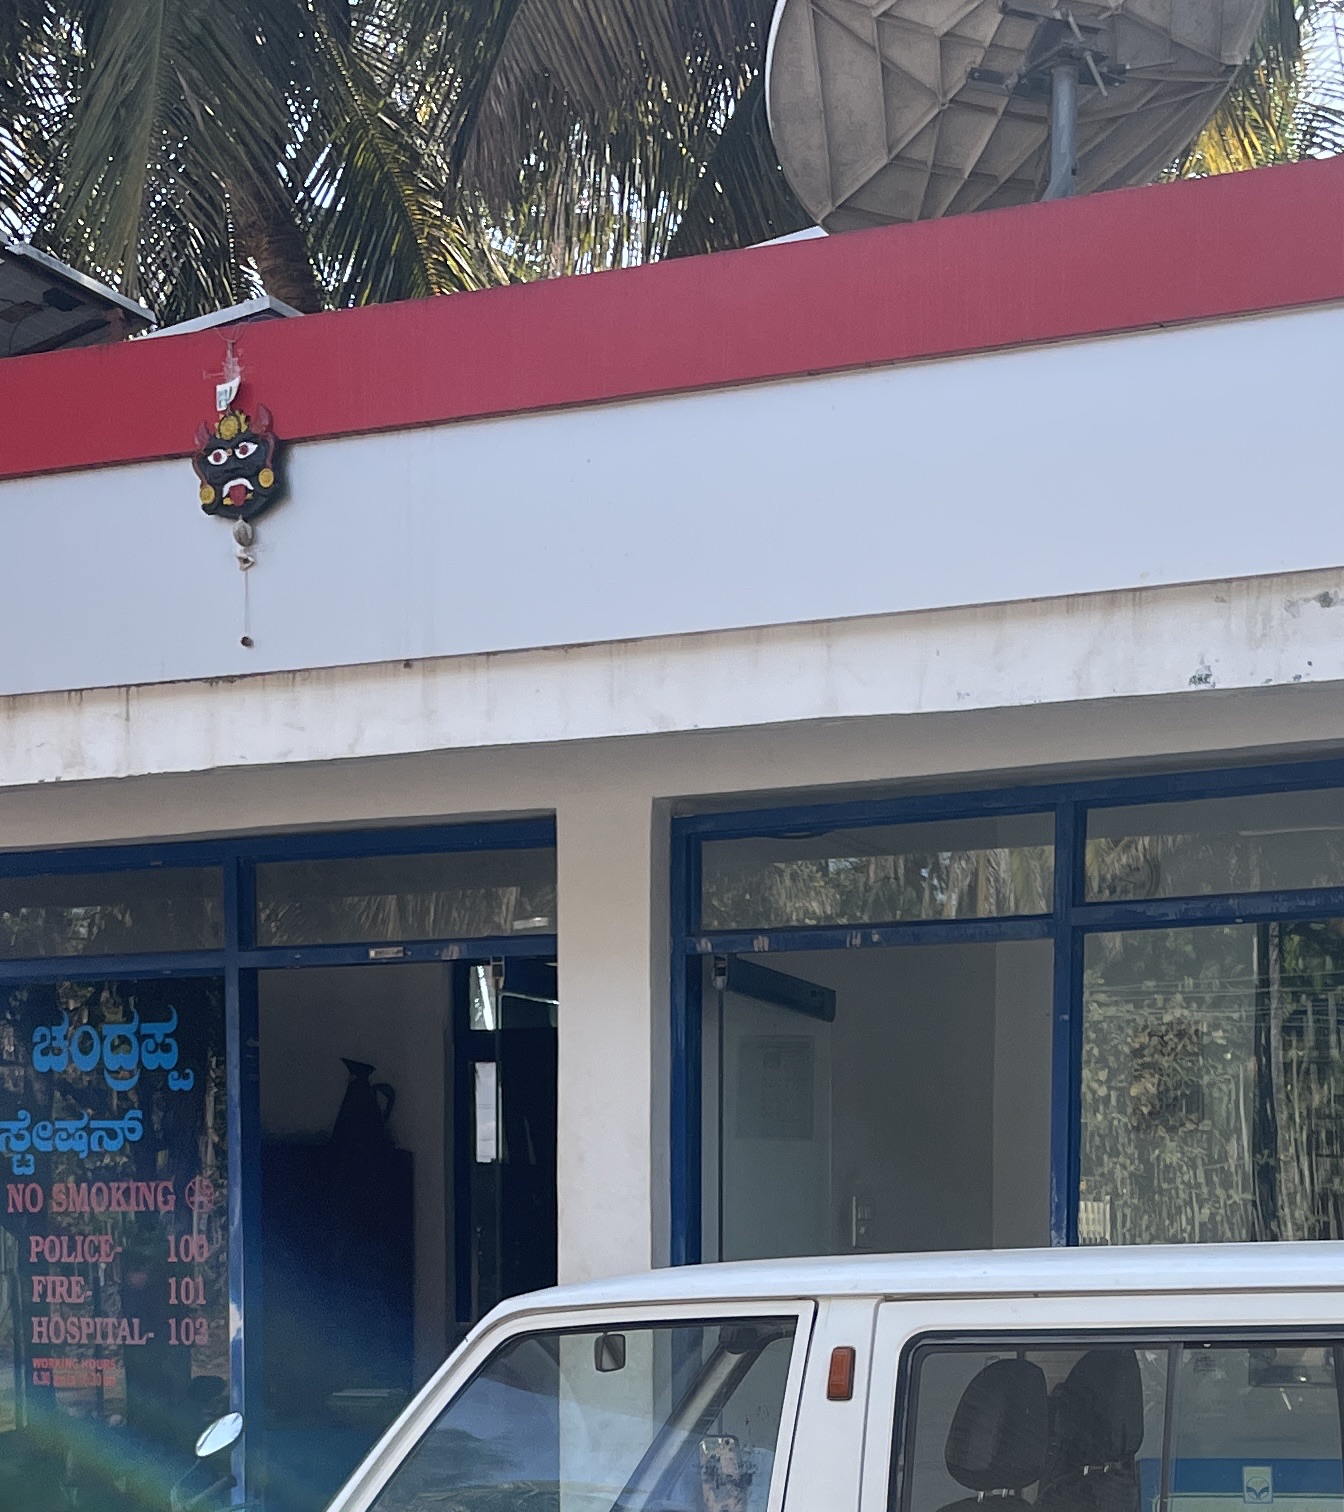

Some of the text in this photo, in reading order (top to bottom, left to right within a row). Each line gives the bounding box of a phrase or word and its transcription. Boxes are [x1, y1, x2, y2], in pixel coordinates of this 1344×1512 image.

[32, 1004, 195, 1092] ಚಂದ್ರಪ್ಪ
[7, 1180, 176, 1213] NO SMOKING
[29, 1235, 123, 1263] POLICE-
[31, 1275, 207, 1305] FIRE- 101
[31, 1316, 155, 1345] HOSPITAL-
